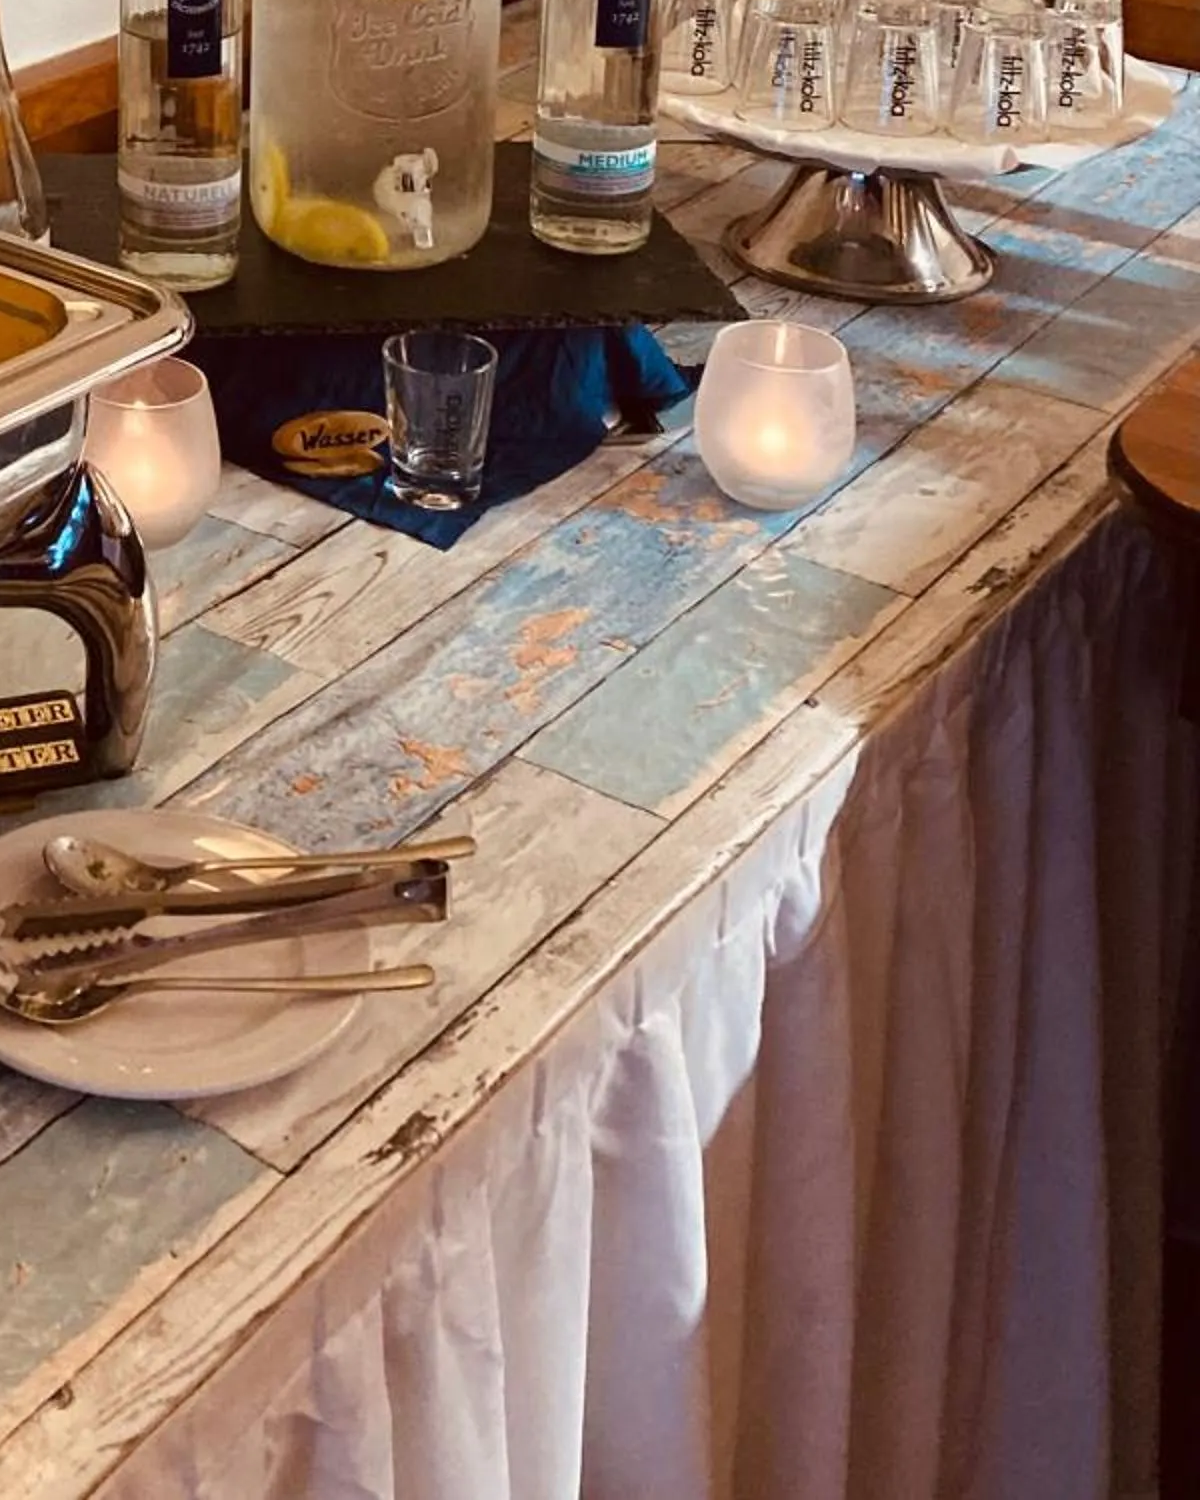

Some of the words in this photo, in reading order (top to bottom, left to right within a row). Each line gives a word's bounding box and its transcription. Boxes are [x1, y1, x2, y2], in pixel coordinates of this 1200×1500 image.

[800, 40, 824, 113] fritz-kola
[997, 55, 1023, 127] fritz-kola
[579, 150, 648, 168] MEDIUM
[300, 423, 382, 452] Wasser
